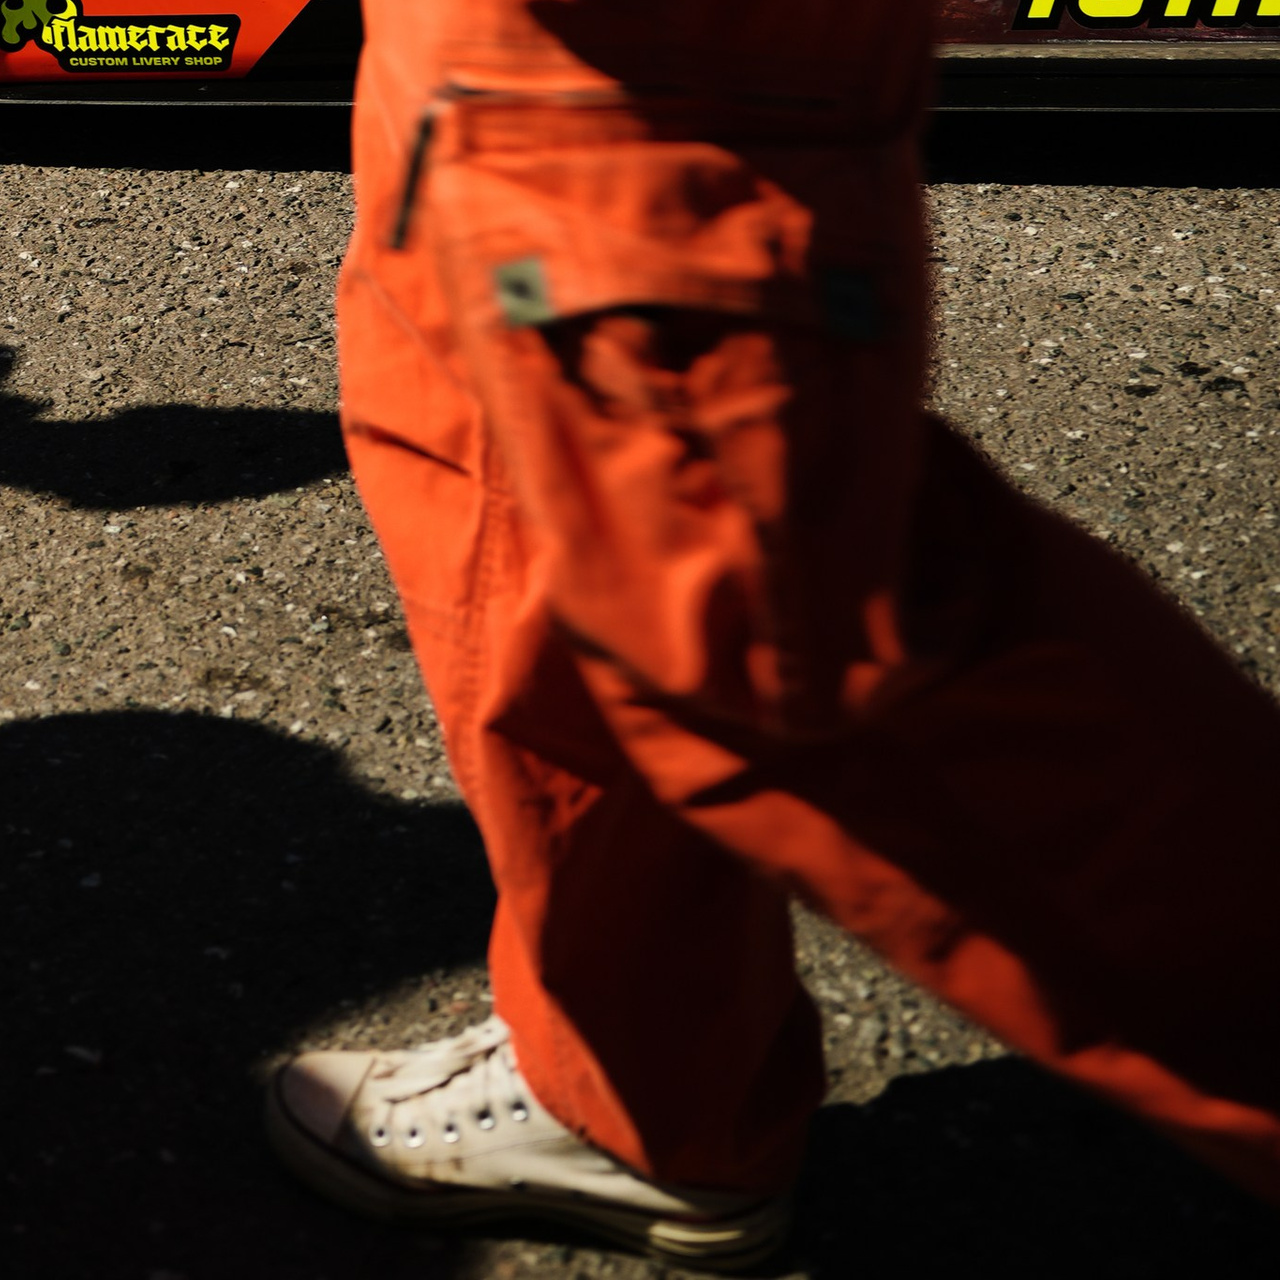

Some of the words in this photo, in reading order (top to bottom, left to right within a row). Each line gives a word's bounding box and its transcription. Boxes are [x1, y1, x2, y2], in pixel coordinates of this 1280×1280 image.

[42, 15, 231, 53] flamerace
[69, 56, 129, 67] CUSTOM
[132, 56, 181, 67] LIVERY
[184, 56, 224, 67] SHOP
